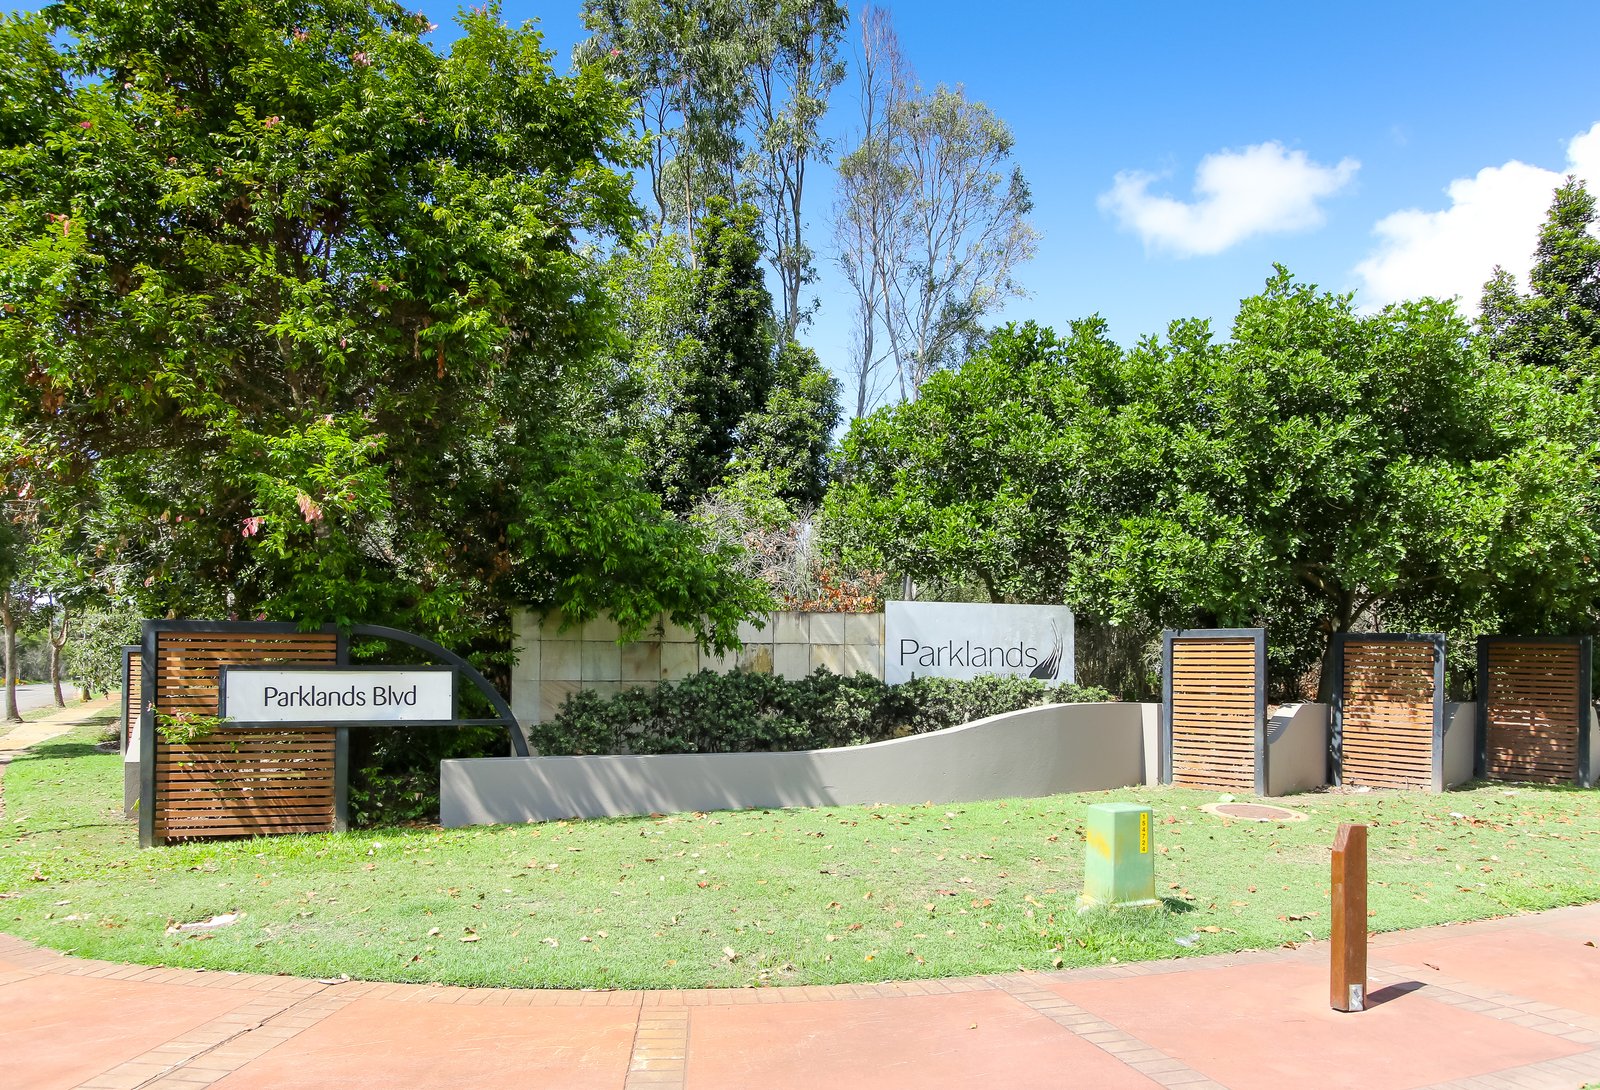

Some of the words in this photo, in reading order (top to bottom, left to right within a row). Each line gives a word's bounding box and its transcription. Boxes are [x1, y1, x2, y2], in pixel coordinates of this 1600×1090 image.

[899, 639, 1038, 667] Parklands
[264, 686, 366, 706] Parklands
[373, 685, 417, 706] Blvd
